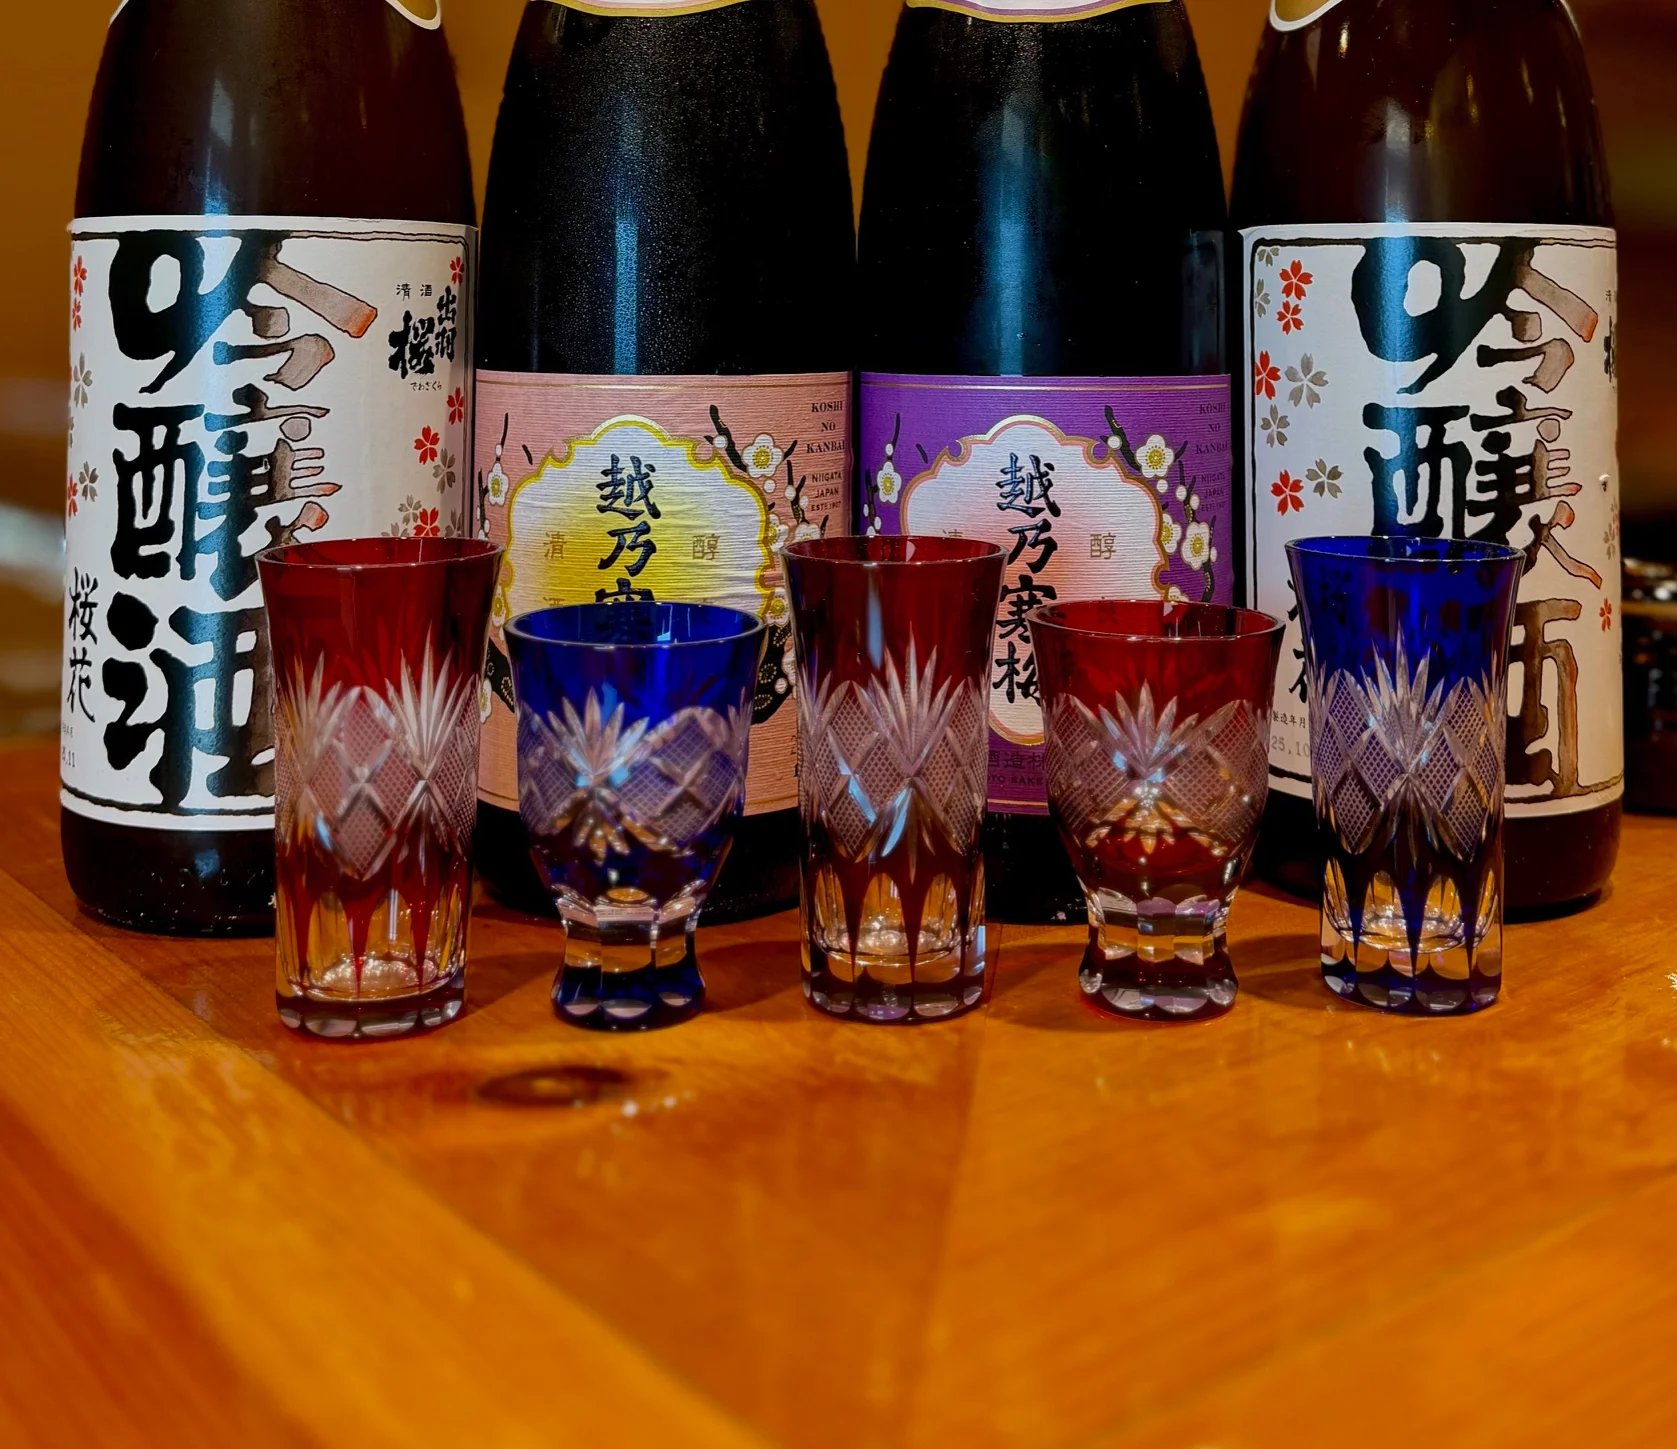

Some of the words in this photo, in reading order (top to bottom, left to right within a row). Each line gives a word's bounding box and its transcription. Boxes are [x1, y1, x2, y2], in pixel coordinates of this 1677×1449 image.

[811, 401, 843, 413] KOSHI
[821, 422, 836, 432] NO
[806, 441, 845, 454] KANBAI
[812, 472, 842, 483] NIIGATA
[815, 488, 839, 499] JAPAN
[67, 566, 99, 724] 桜花
